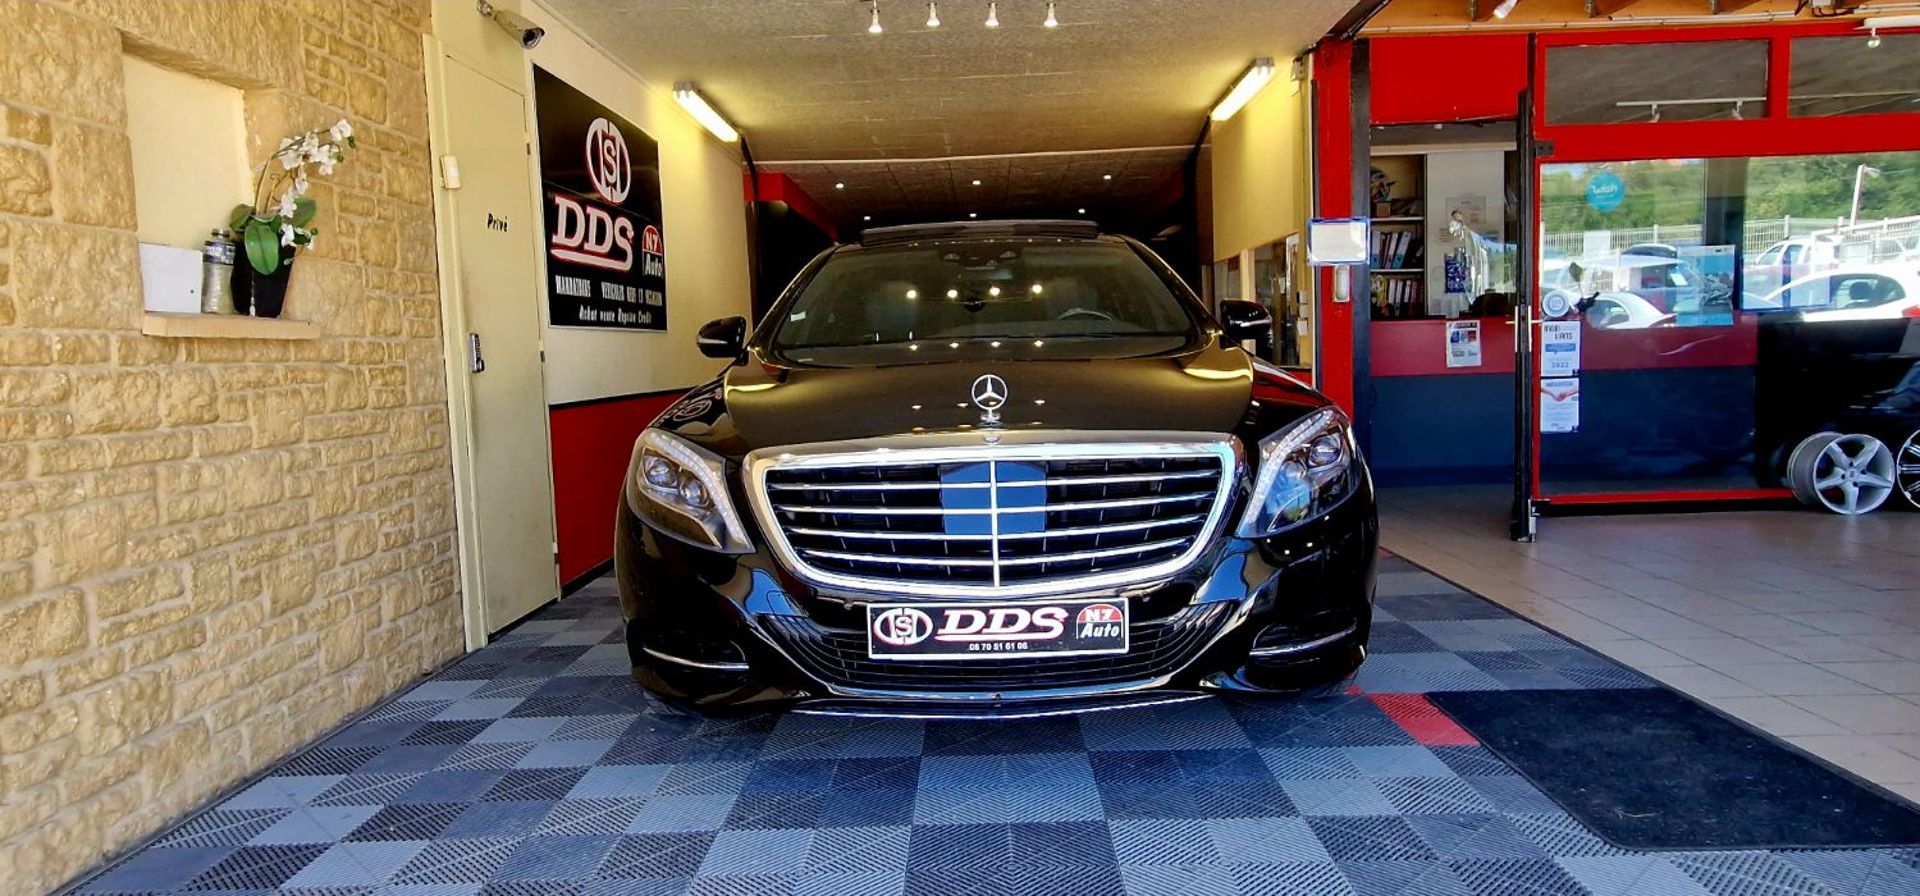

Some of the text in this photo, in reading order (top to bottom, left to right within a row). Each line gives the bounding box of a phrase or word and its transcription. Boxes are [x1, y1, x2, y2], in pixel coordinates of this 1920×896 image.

[487, 213, 508, 233] Privé
[551, 196, 634, 271] DDS
[645, 231, 660, 252] N7
[644, 254, 662, 278] Auto
[934, 607, 1069, 642] DDS
[1085, 609, 1114, 622] N7
[1080, 622, 1120, 638] Auto
